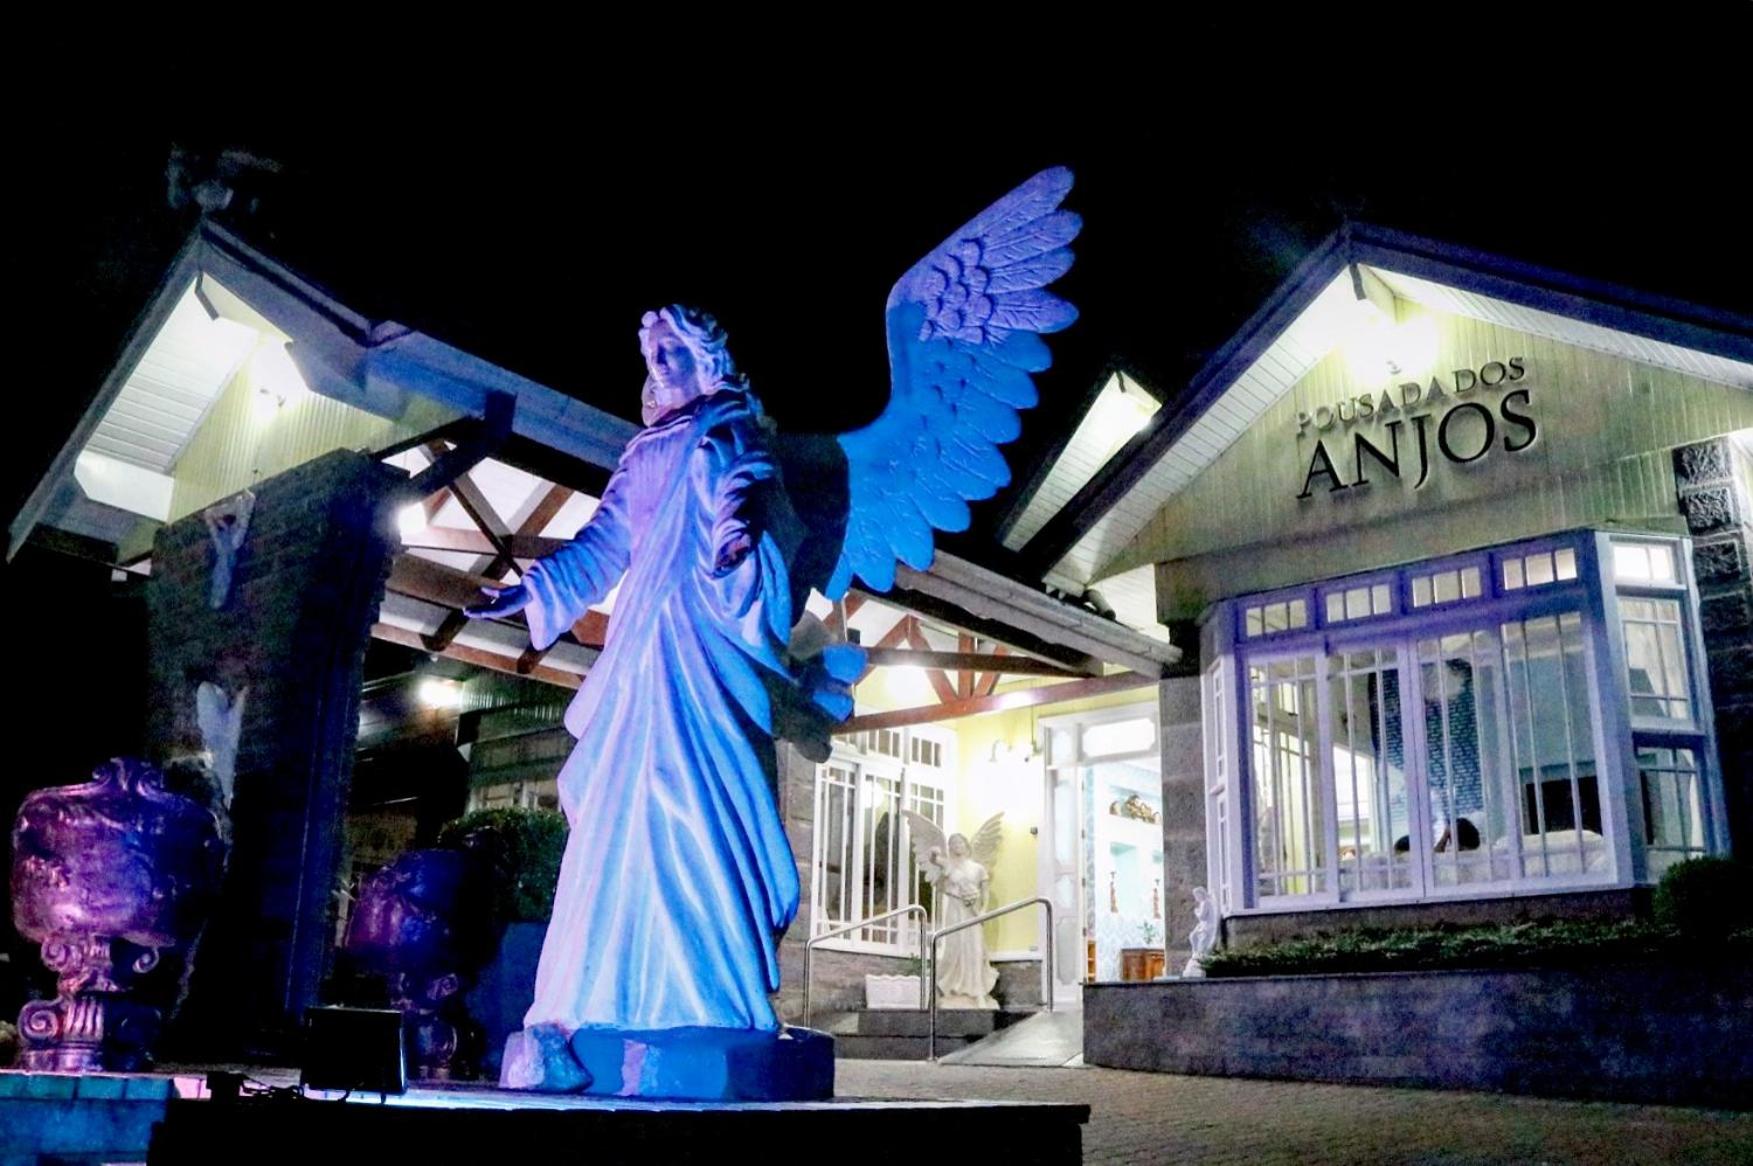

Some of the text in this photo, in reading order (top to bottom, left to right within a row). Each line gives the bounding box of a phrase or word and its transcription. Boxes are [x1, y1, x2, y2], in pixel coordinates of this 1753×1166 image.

[1297, 357, 1525, 435] POUSADA DOS
[1296, 389, 1537, 499] ANJOS
